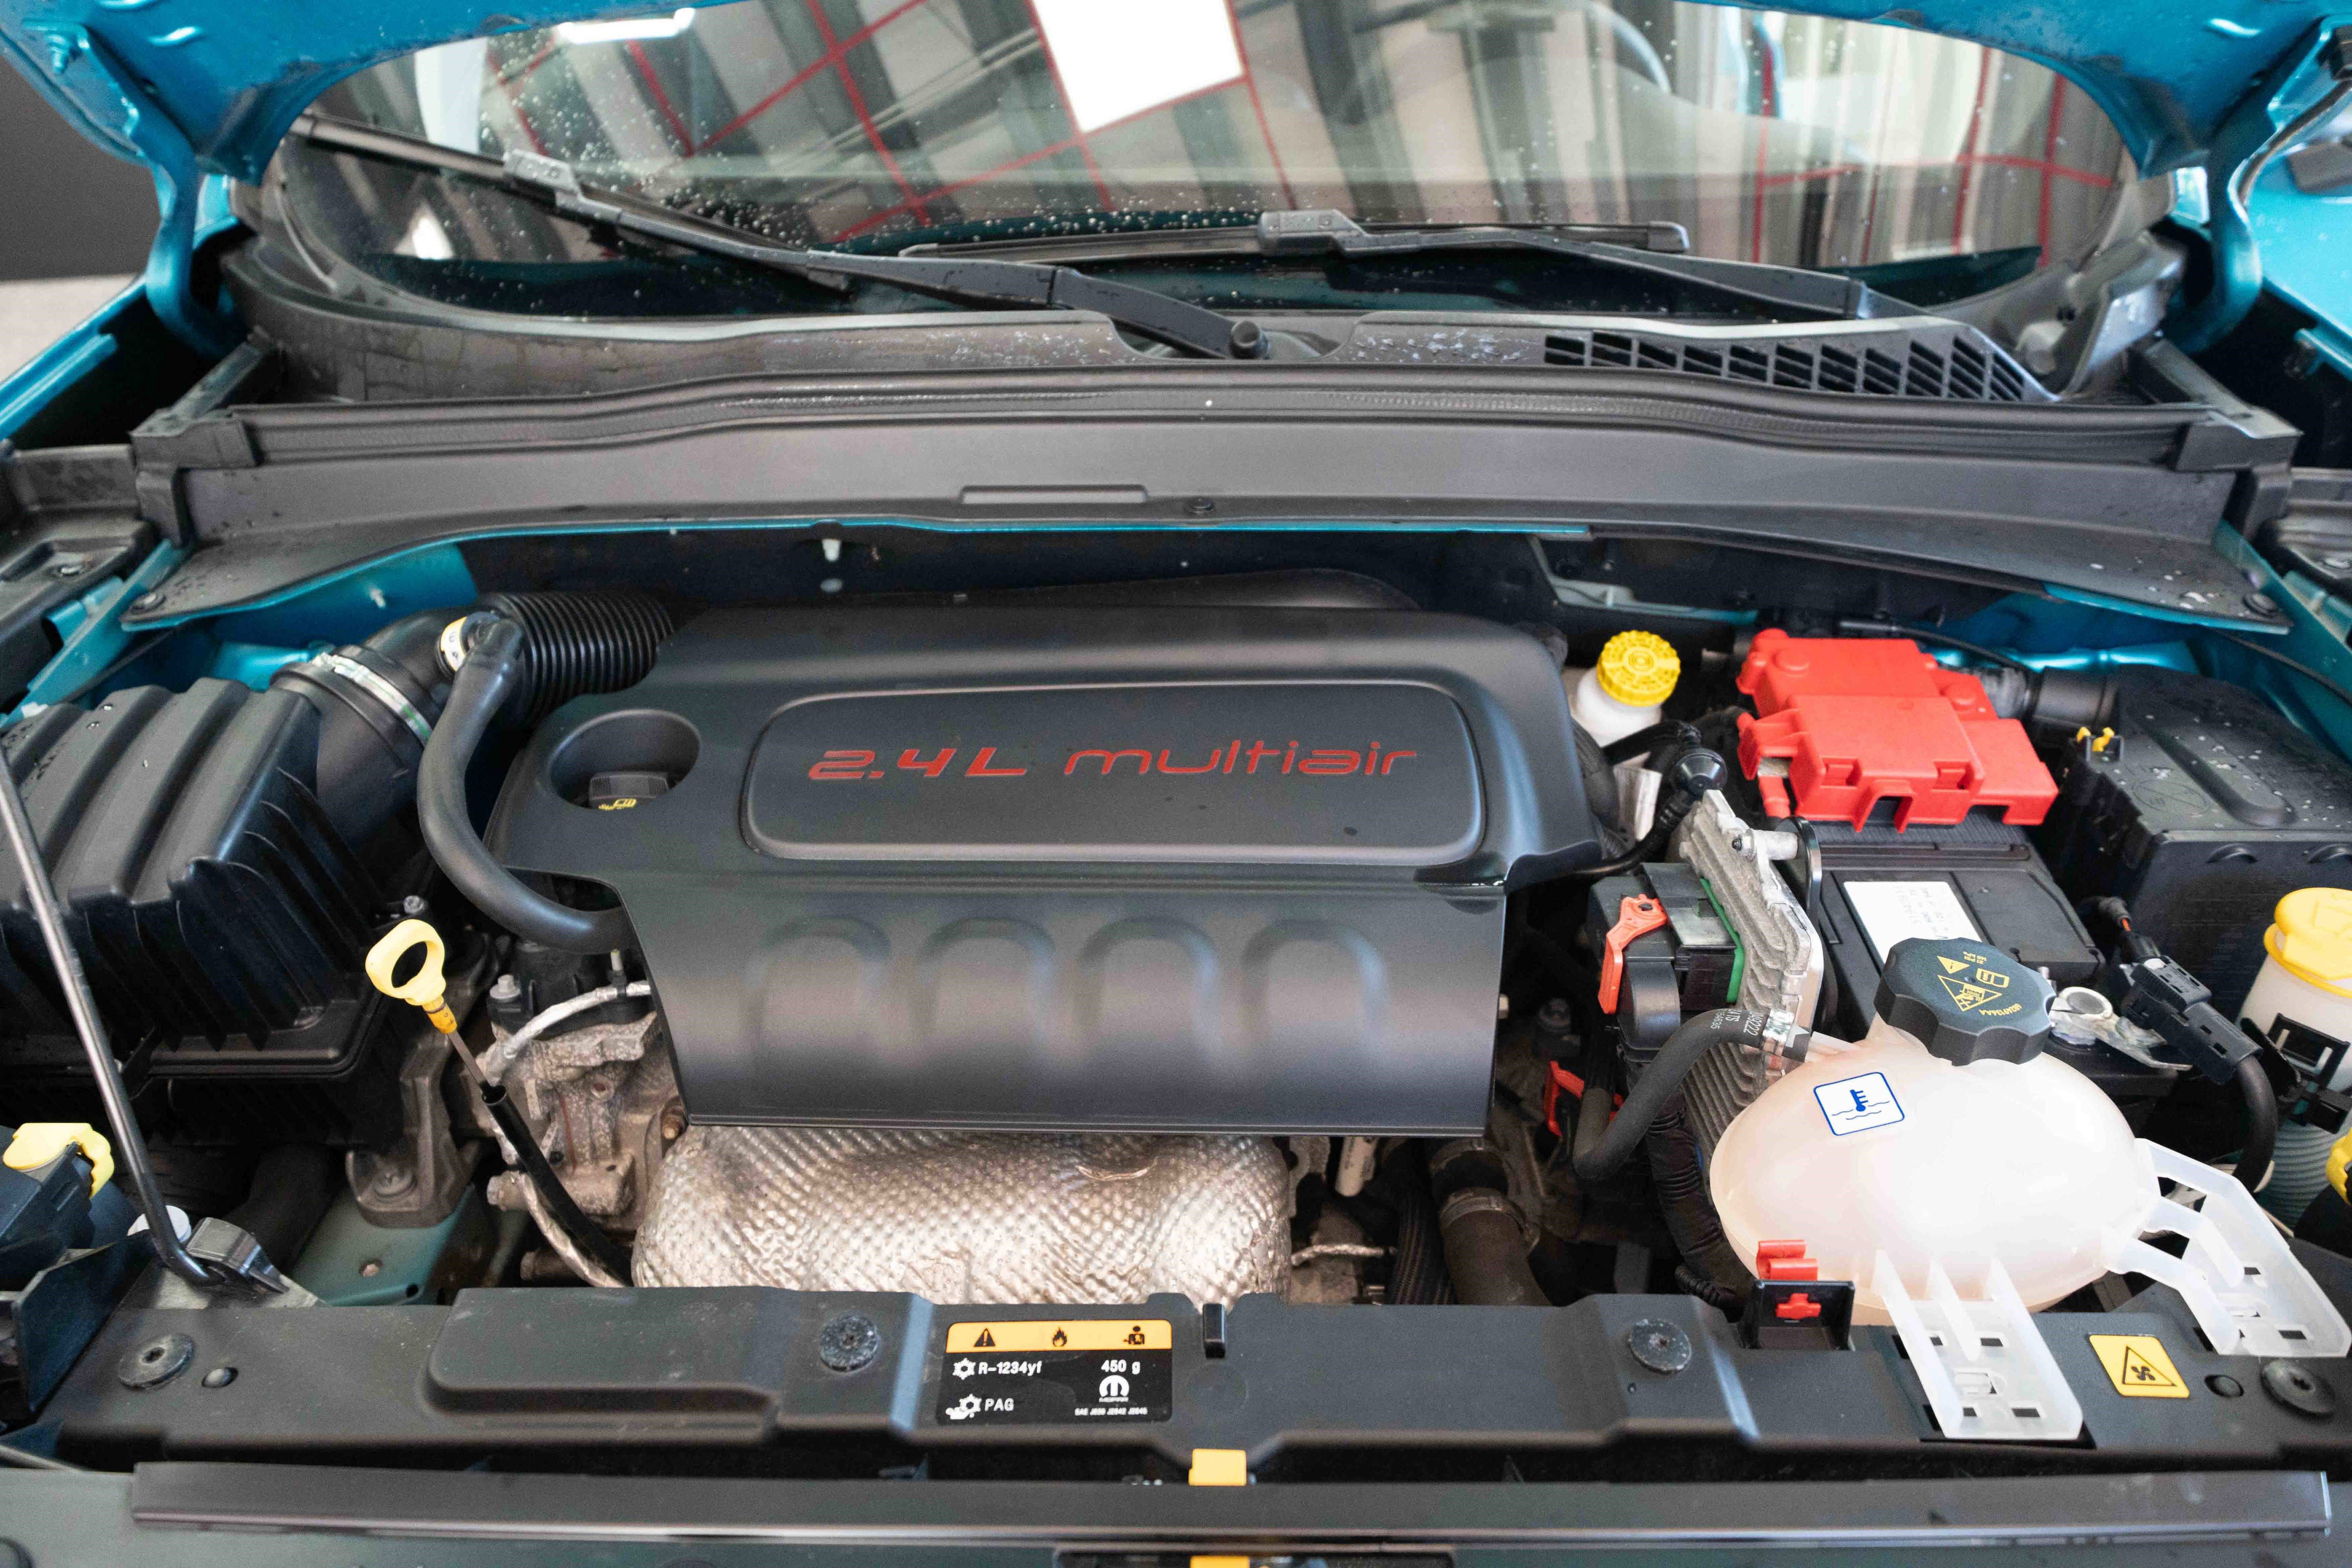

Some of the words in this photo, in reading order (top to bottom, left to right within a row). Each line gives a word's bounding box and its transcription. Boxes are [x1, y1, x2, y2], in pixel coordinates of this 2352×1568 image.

[1065, 740, 1415, 774] multiair
[978, 1361, 1042, 1376] R-1234yf
[1101, 1359, 1127, 1372] 450
[1131, 1361, 1140, 1375] g
[984, 1398, 1014, 1412] PAG
